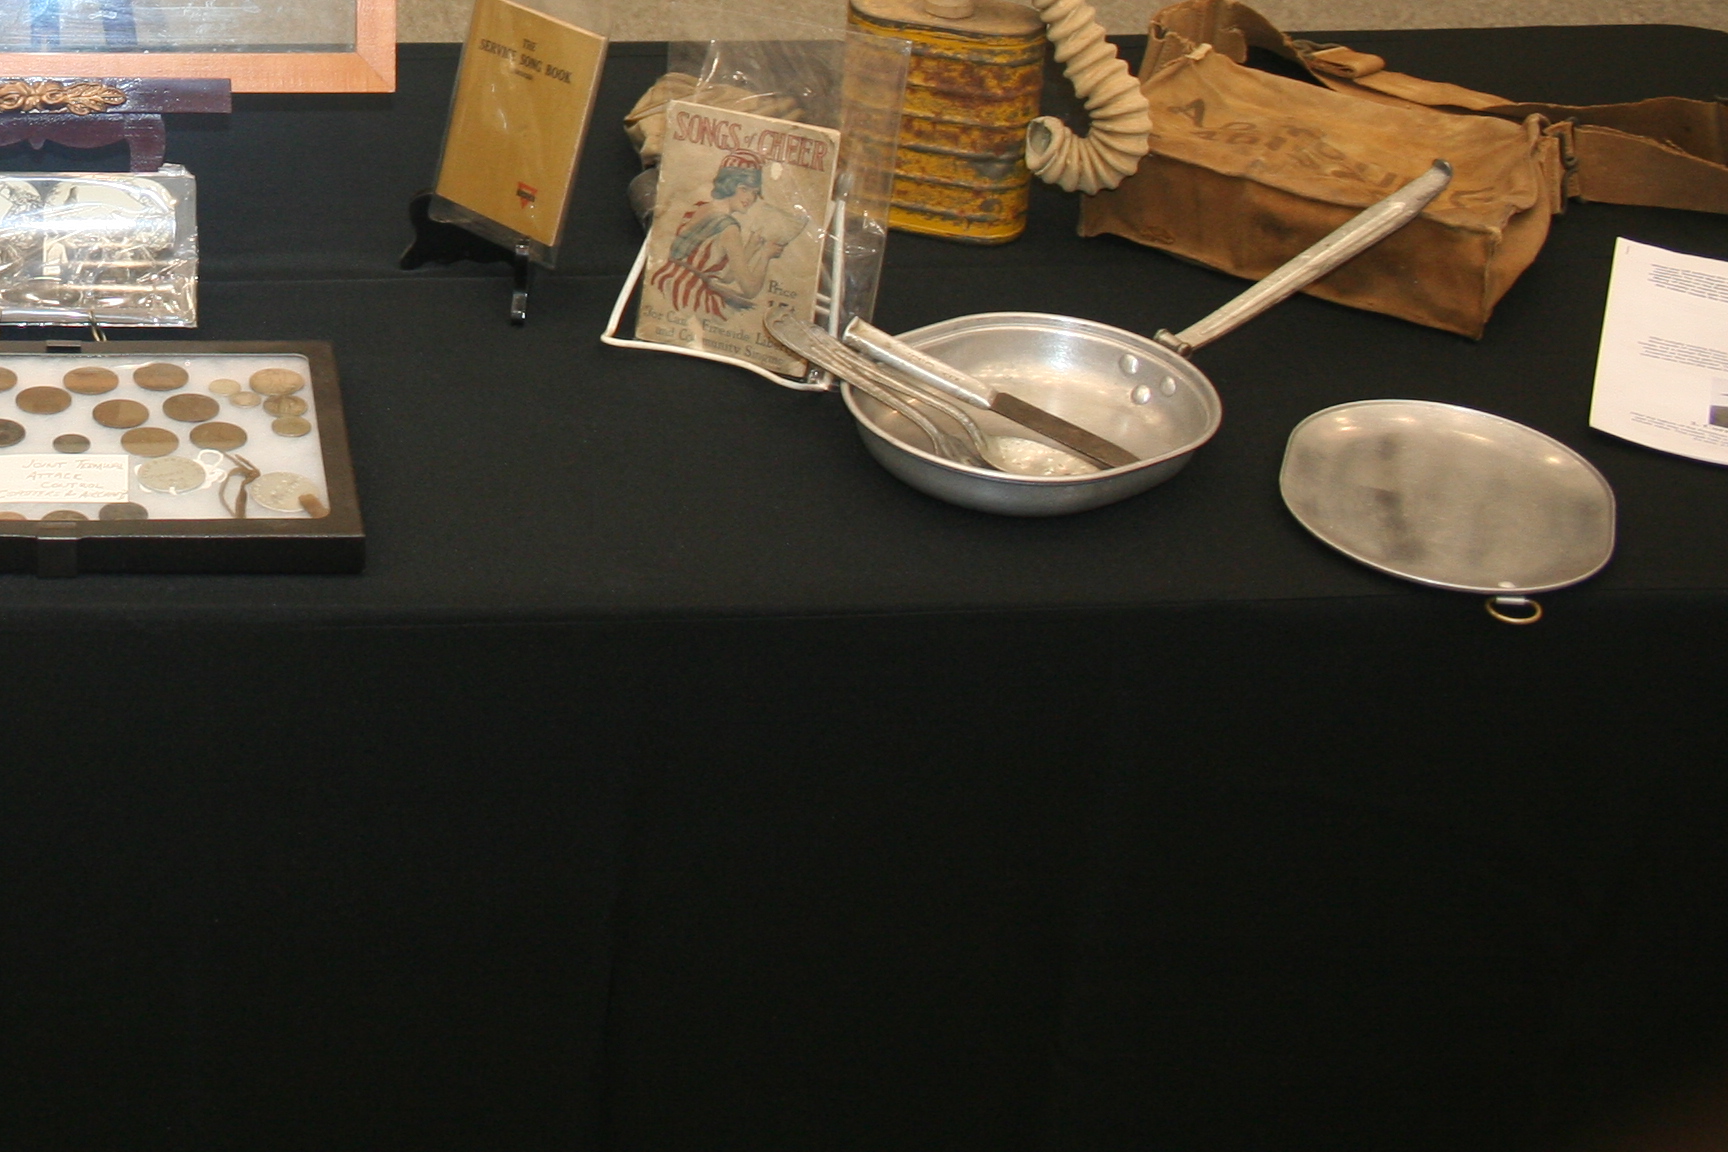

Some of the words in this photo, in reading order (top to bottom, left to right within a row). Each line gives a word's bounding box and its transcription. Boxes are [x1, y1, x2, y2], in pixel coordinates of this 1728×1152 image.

[520, 53, 543, 73] SONG
[545, 64, 572, 84] BOOK
[673, 111, 742, 151] SONGS
[758, 129, 828, 173] CHEER
[767, 279, 798, 298] Price
[702, 318, 751, 342] Fireside
[22, 459, 68, 469] JOINT
